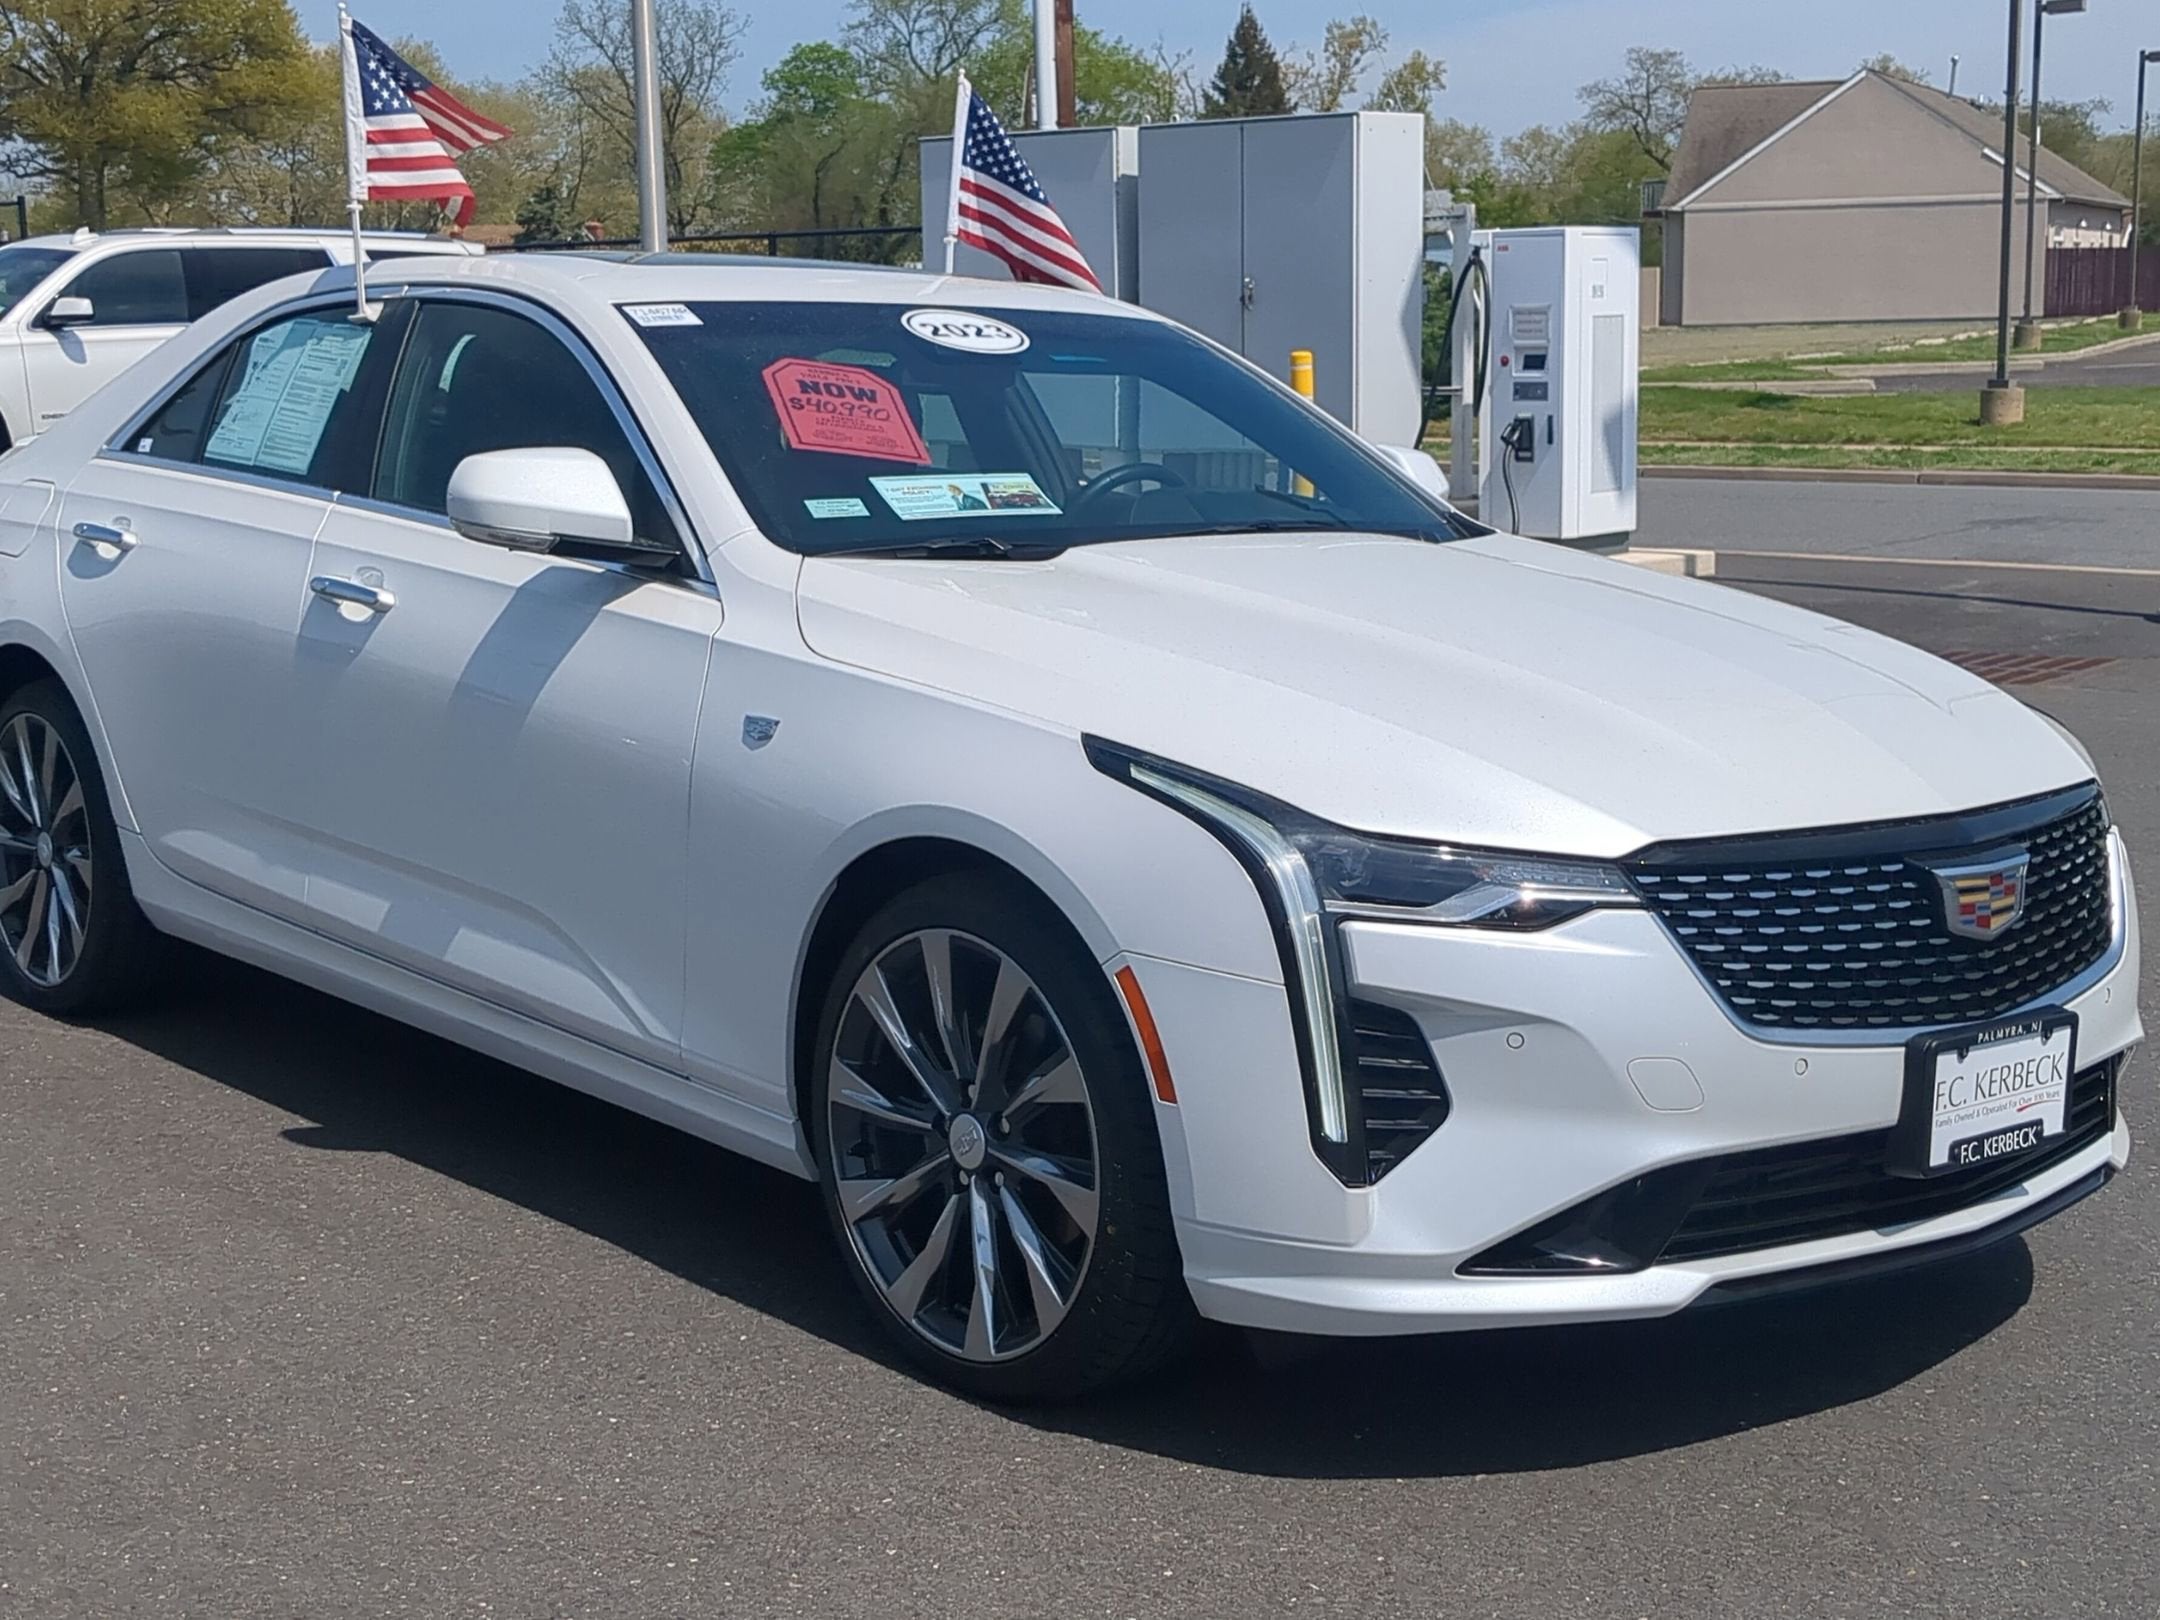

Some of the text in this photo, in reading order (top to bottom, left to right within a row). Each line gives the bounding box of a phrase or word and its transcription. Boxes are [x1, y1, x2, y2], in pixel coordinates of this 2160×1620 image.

[918, 323, 1013, 339] 2023
[795, 379, 878, 404] NOW
[1977, 1024, 2027, 1044] PALMYRA,
[1935, 1051, 2065, 1112] F.C. KERBECK
[1960, 1125, 2038, 1165] F.C. KERBECK
